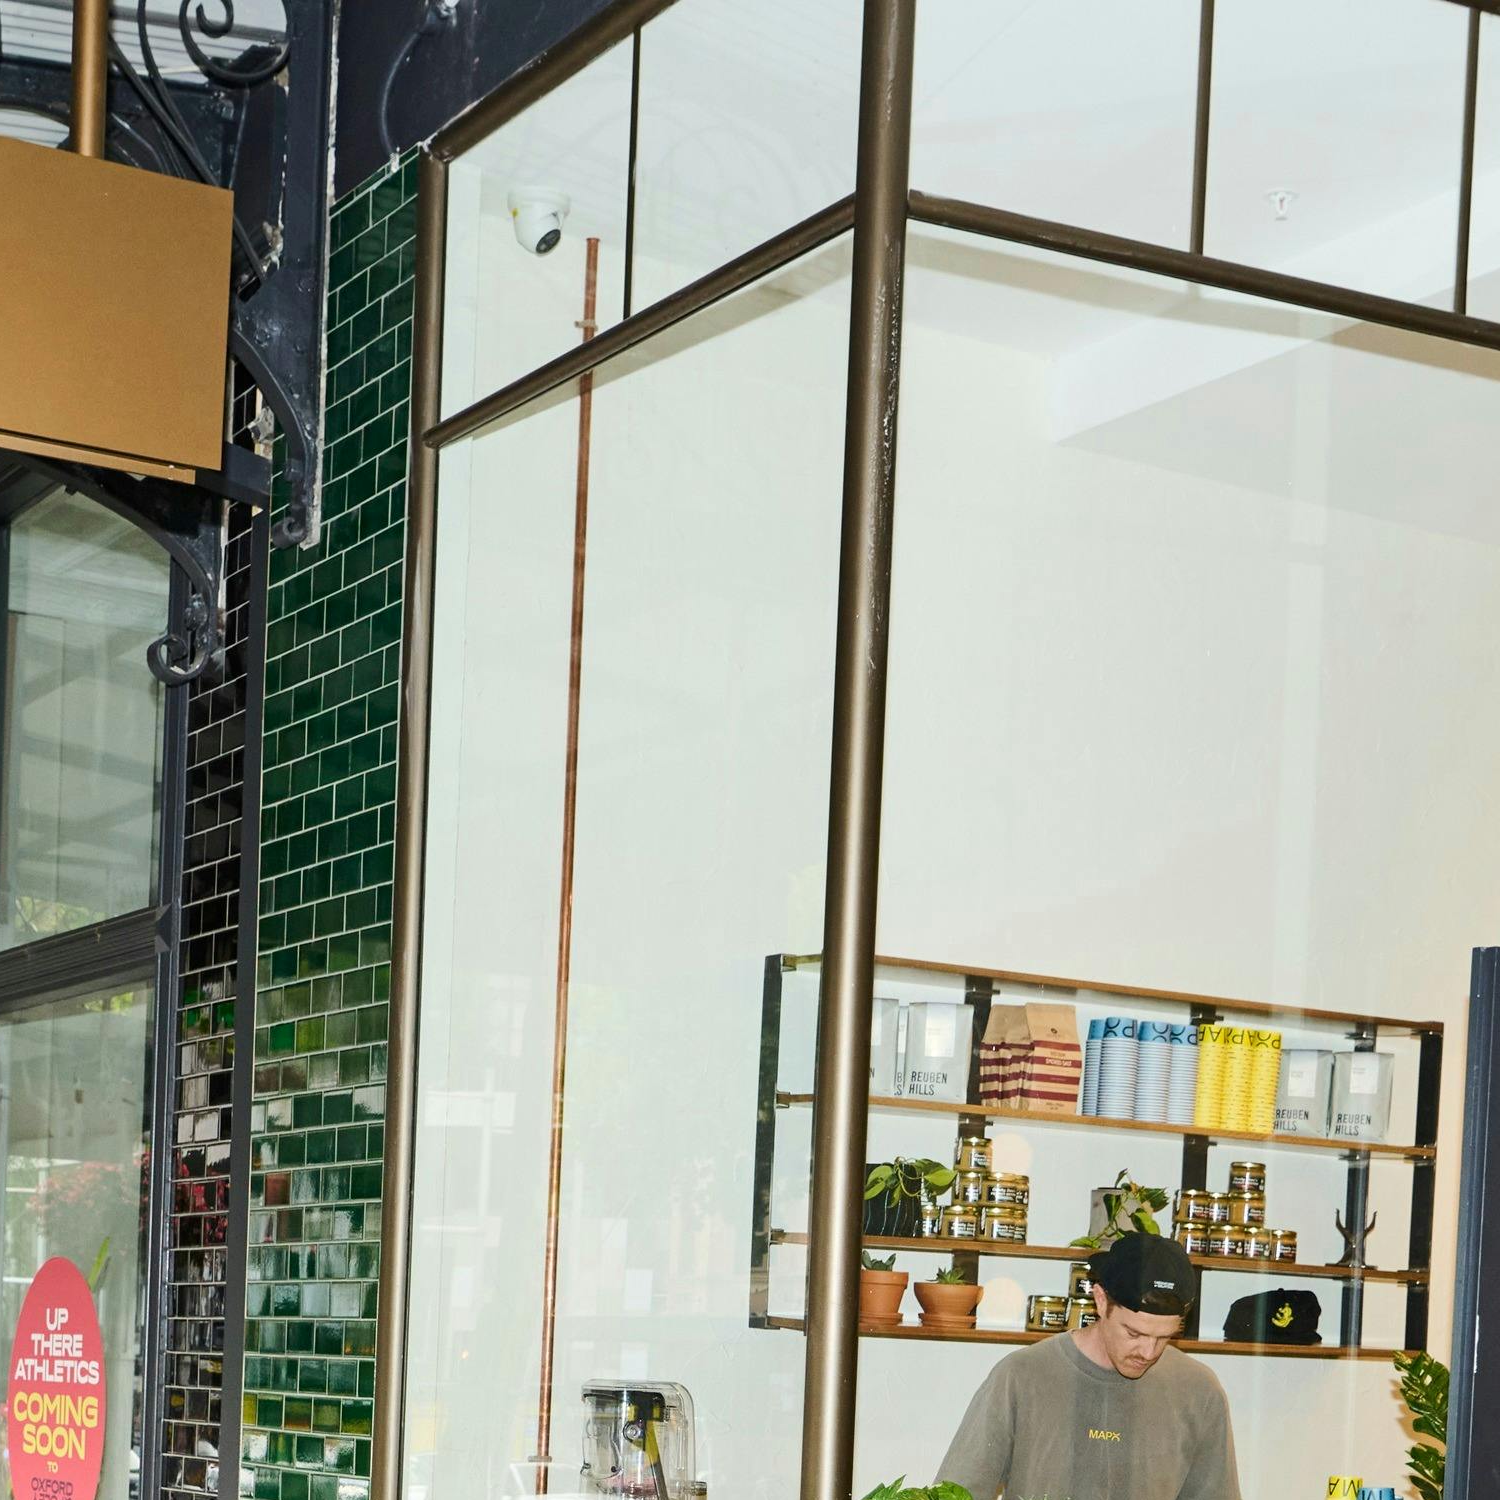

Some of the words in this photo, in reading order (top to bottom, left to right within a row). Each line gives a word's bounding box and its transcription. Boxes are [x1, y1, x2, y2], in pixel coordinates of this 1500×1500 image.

[910, 1070, 948, 1085] REUBEN
[908, 1083, 935, 1096] HILLS
[1275, 1108, 1309, 1121] REUBEN
[1336, 1113, 1372, 1125] REUBEN
[1274, 1120, 1297, 1132] HILLS
[1334, 1124, 1360, 1137] HILLS
[46, 1308, 68, 1331] UP
[31, 1333, 83, 1357] THERE
[14, 1358, 100, 1385] ATHLETICS
[13, 1391, 99, 1429] COMING
[22, 1423, 86, 1461] SOON
[47, 1461, 58, 1473] TO
[31, 1477, 73, 1496] OXFORD
